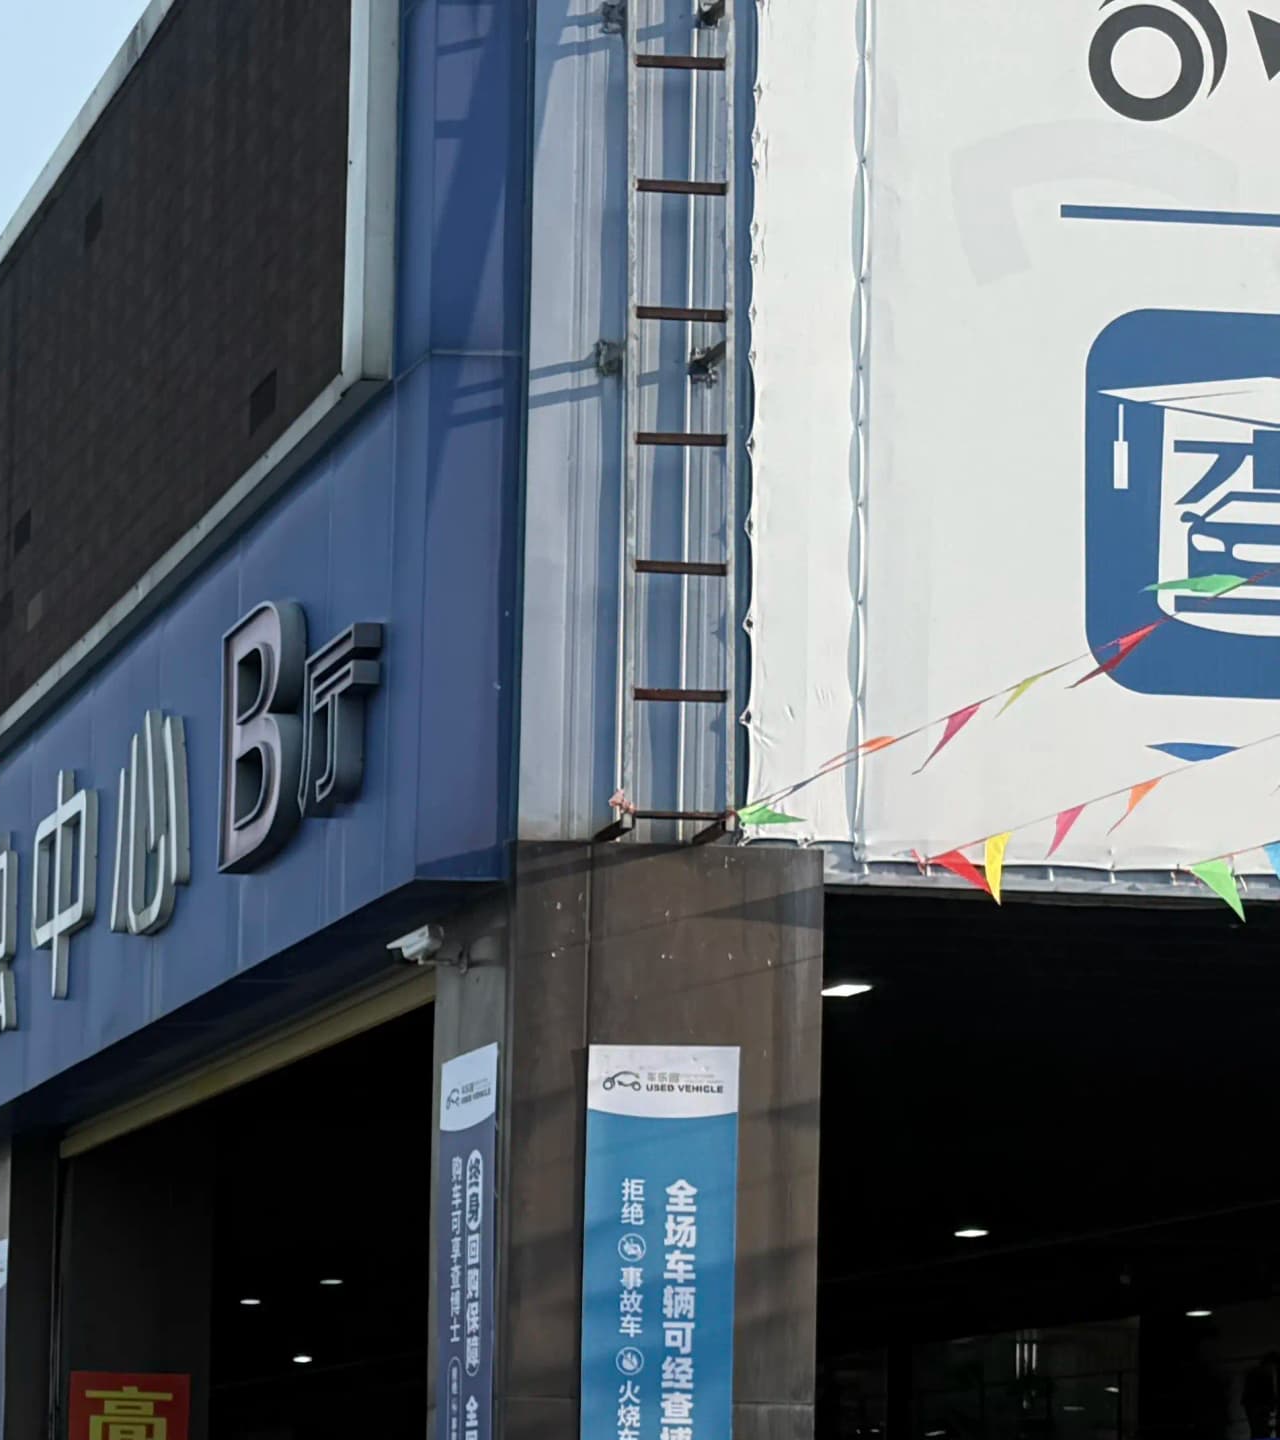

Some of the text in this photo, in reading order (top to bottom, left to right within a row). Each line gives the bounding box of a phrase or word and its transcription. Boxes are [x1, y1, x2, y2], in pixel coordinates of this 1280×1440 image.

[216, 600, 384, 875] B厅
[646, 1084, 724, 1094] USED VEHICLE
[620, 1178, 646, 1225] 拒绝
[618, 1266, 644, 1338] 事故车
